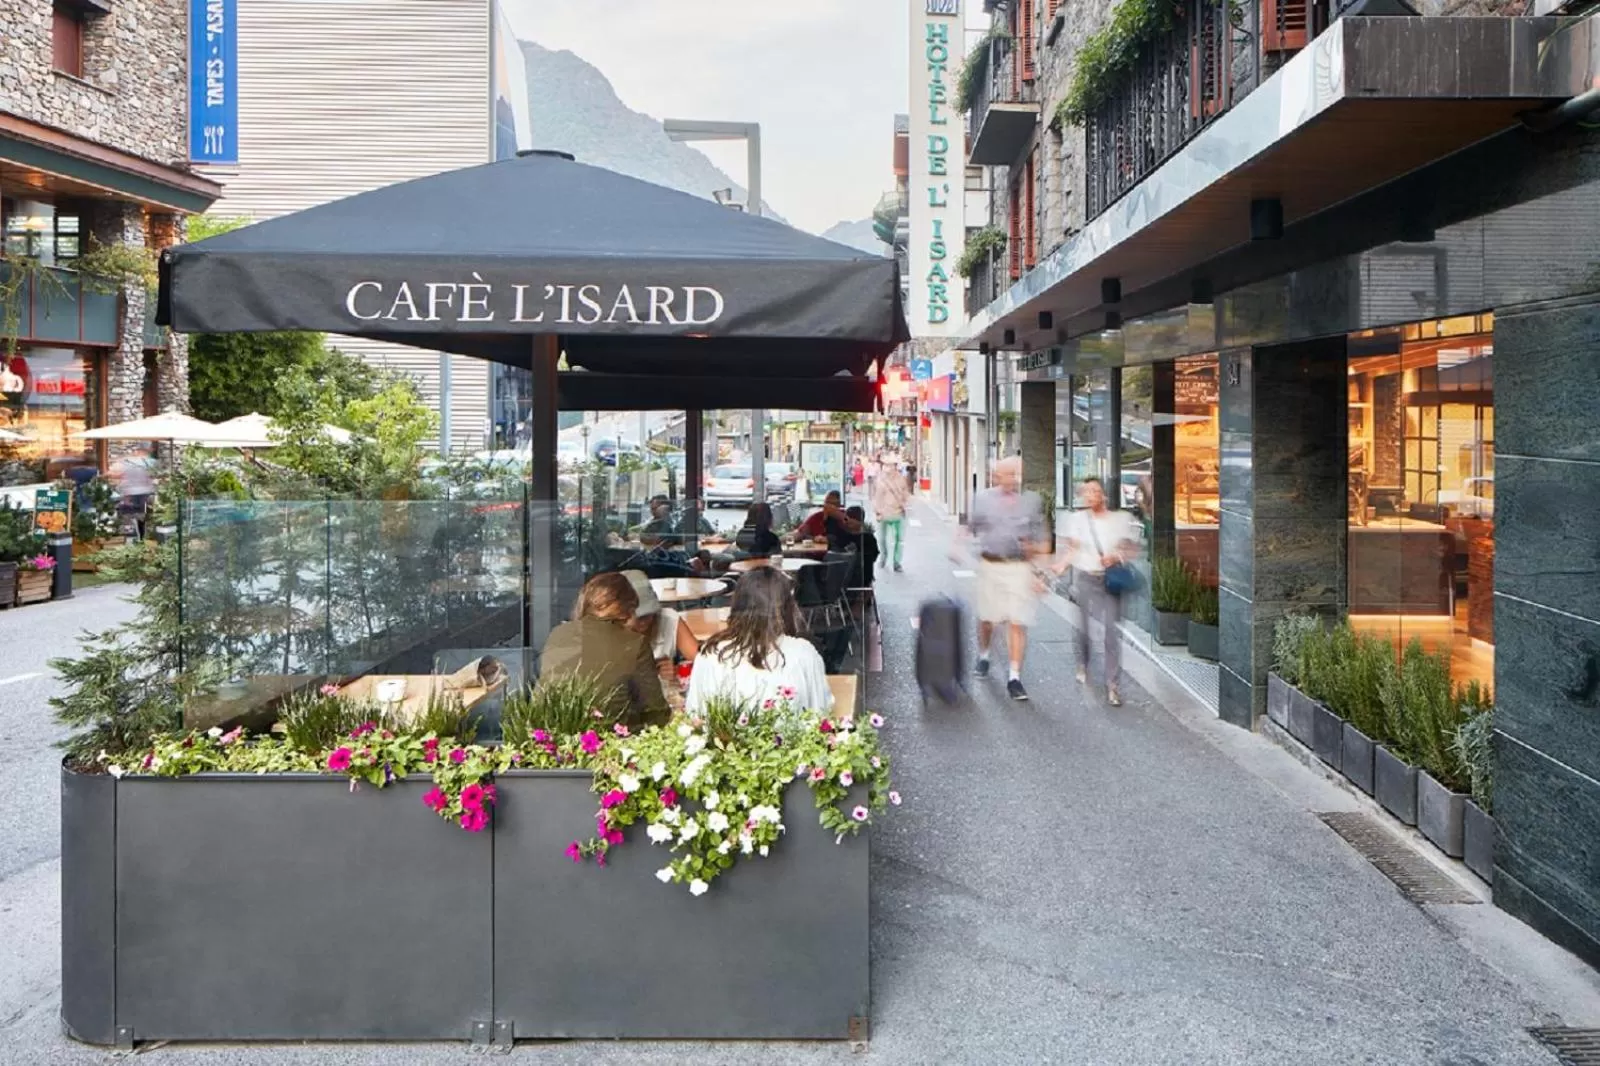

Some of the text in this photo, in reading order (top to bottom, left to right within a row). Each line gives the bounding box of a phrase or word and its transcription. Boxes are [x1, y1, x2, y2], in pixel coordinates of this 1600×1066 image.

[207, 59, 224, 107] TAPES
[926, 23, 948, 125] HOTEL
[928, 135, 949, 176] DE
[926, 219, 948, 324] ISARD
[345, 272, 724, 325] CAFÈ L'ISARD
